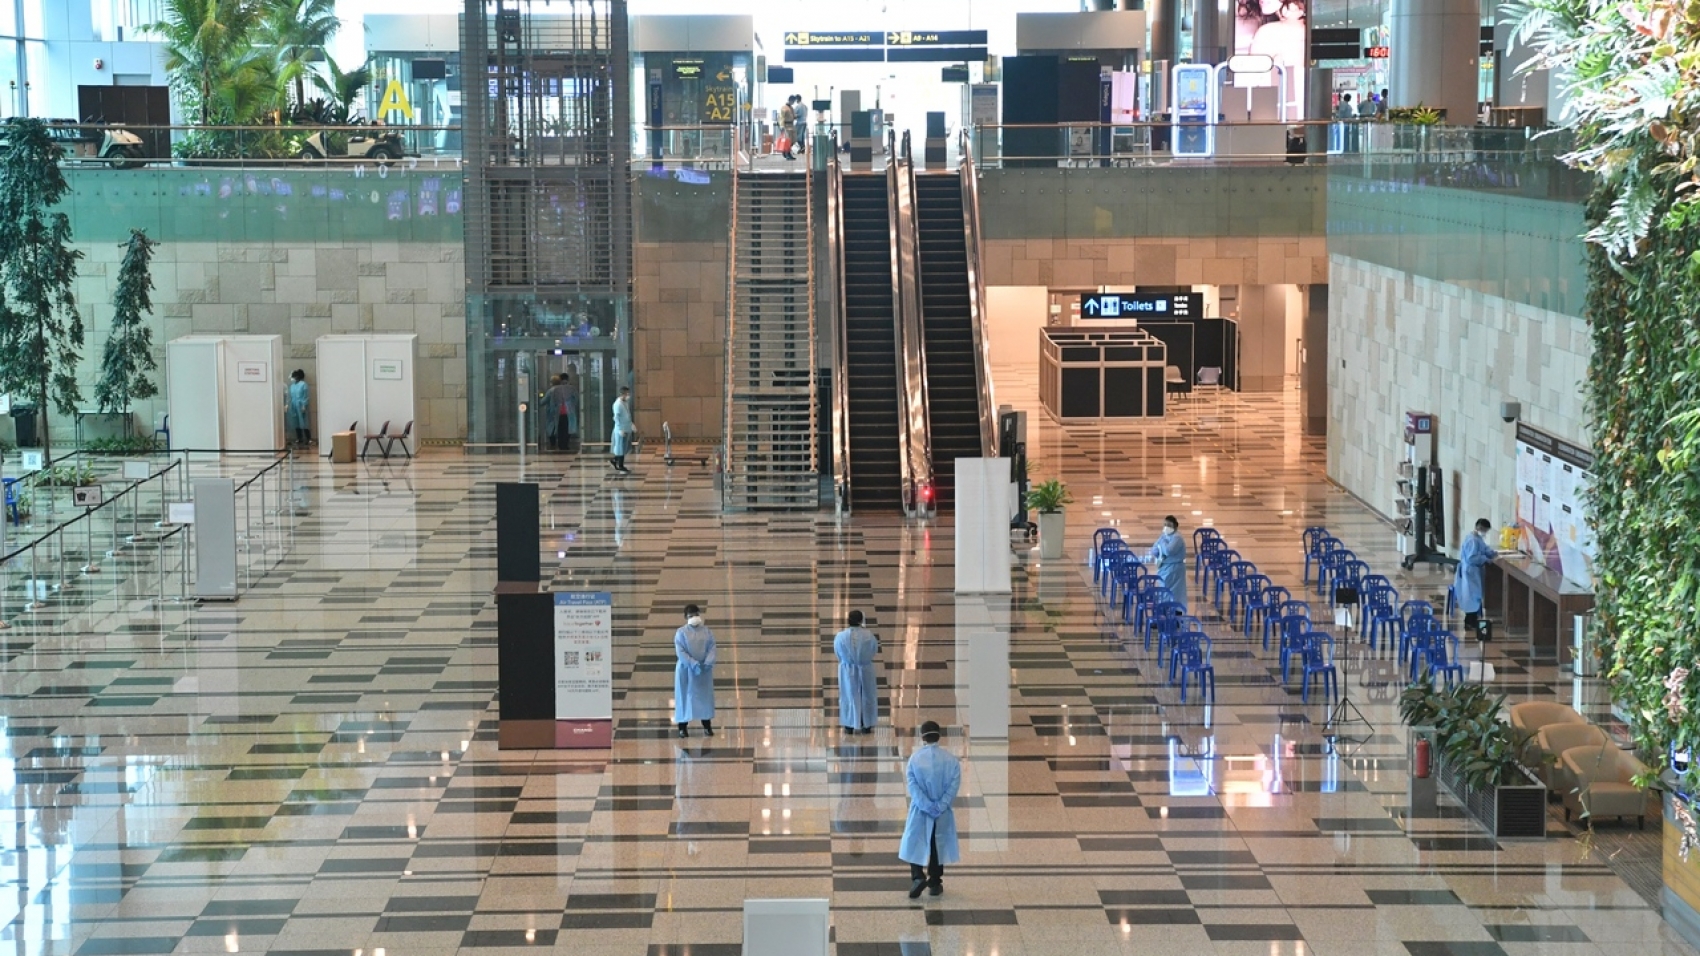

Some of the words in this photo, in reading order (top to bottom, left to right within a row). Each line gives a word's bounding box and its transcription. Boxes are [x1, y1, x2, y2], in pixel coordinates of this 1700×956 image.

[810, 35, 834, 43] Skytrain
[378, 80, 414, 118] A
[706, 94, 735, 106] A15
[1121, 300, 1153, 311] Toilets
